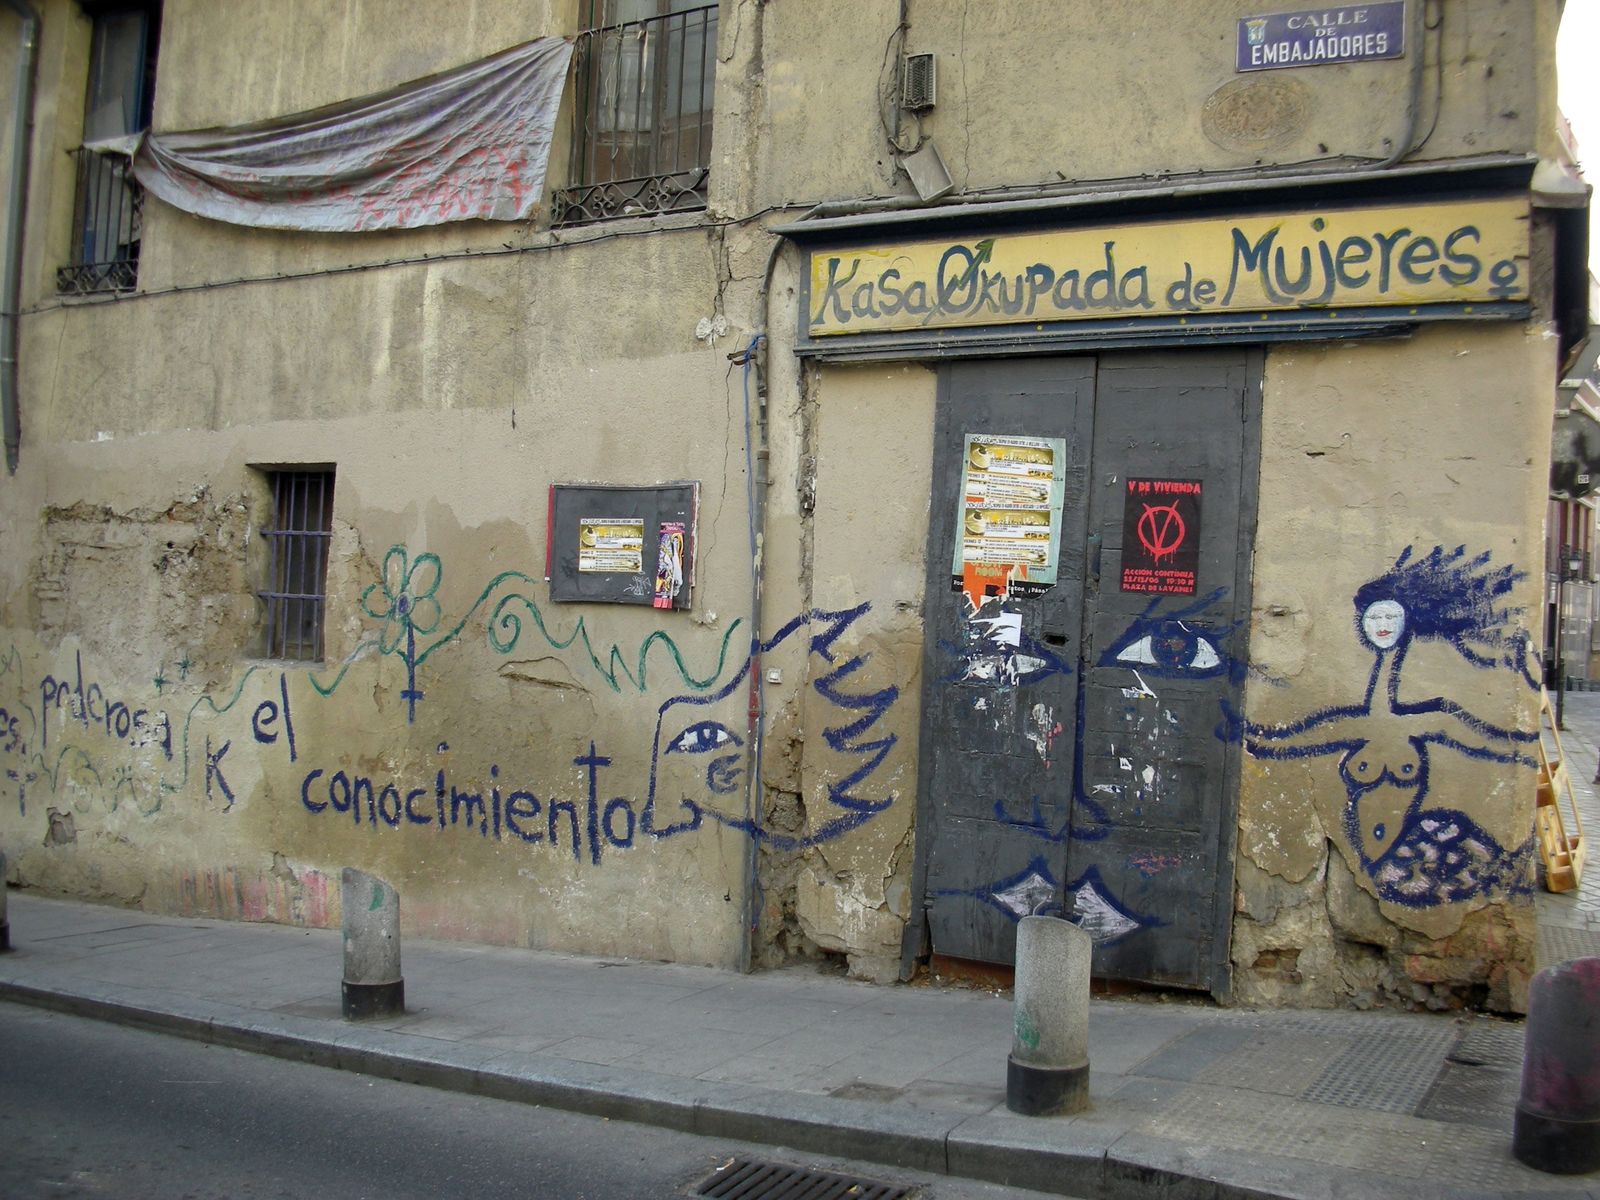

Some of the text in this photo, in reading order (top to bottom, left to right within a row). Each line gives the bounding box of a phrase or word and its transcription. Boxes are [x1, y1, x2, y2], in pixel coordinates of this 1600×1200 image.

[1287, 9, 1369, 30] CALLE
[1315, 27, 1338, 38] DE
[1251, 32, 1388, 66] EMBAJADORES
[1165, 261, 1217, 312] de
[1220, 217, 1482, 309] Mujeres
[1128, 481, 1201, 494] V DE VIVIENDA
[252, 671, 298, 763] el
[301, 740, 637, 867] conocimiento
